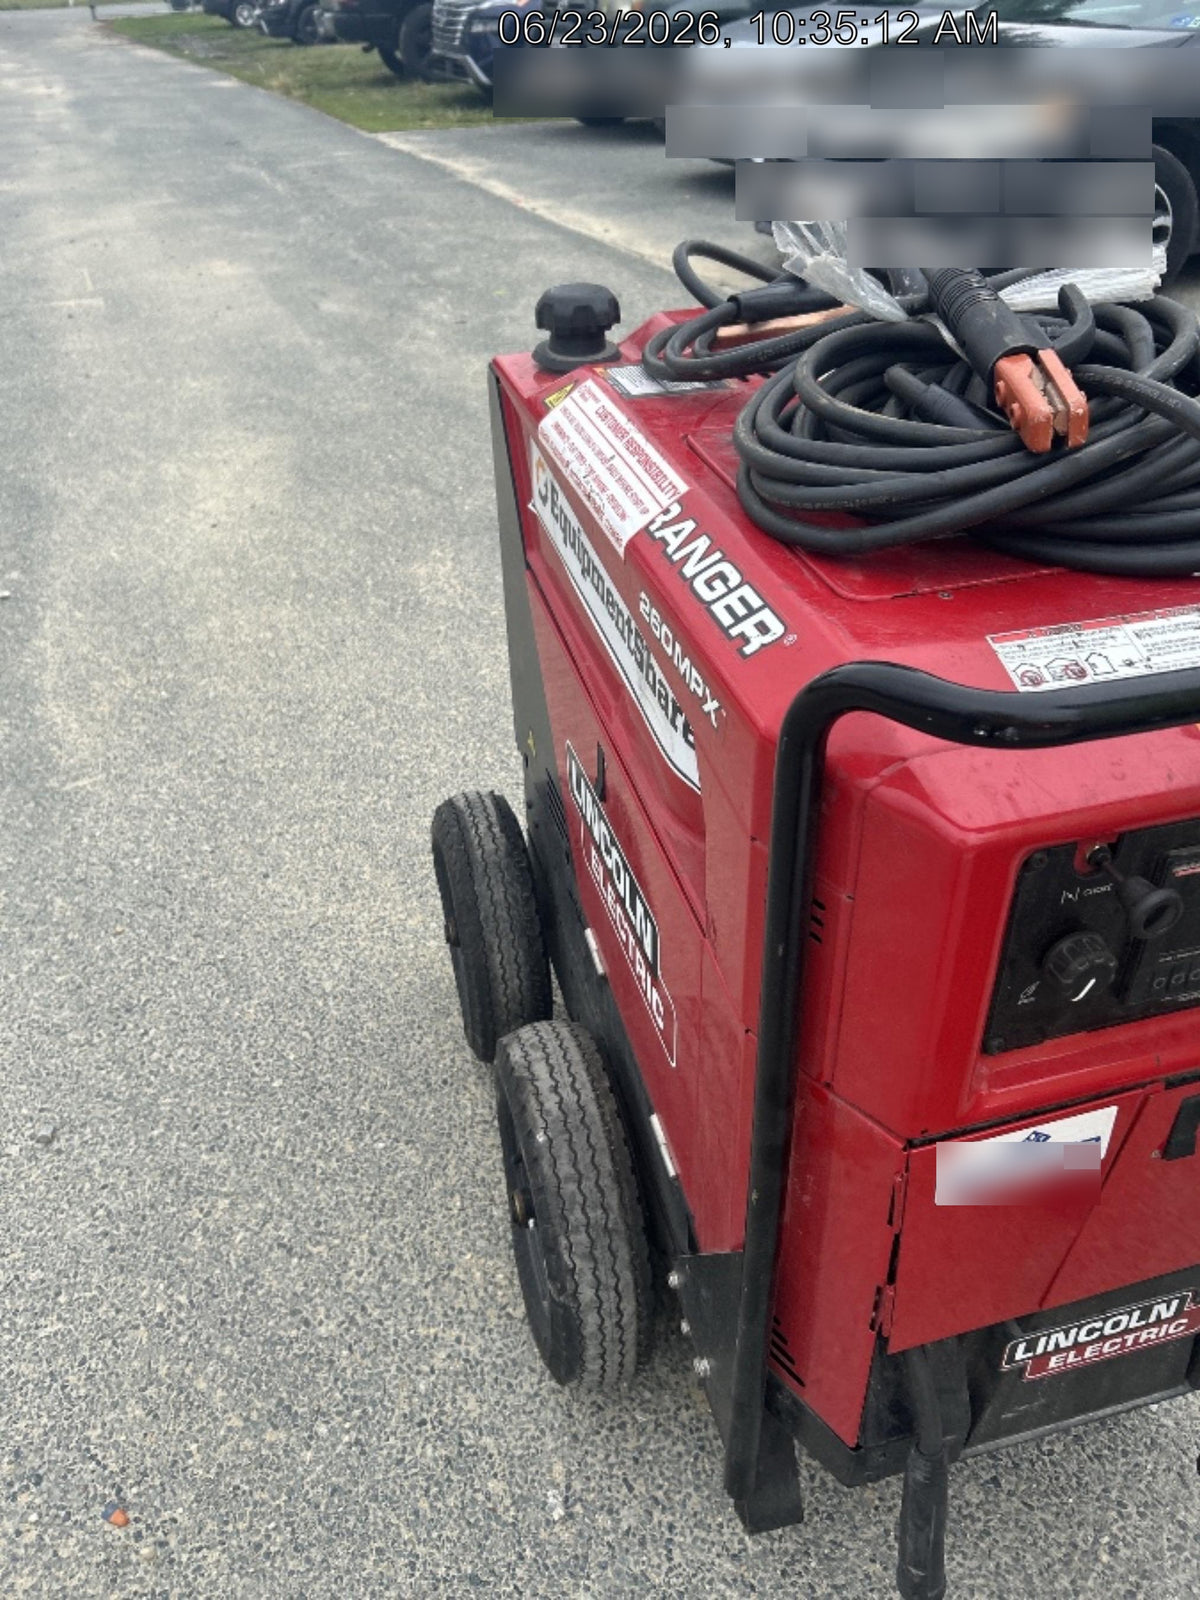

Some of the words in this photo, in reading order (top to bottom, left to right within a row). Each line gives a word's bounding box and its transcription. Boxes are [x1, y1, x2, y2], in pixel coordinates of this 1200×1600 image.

[595, 405, 630, 442] CUSTOMER
[626, 435, 681, 500] RESPONSIBILITY
[549, 487, 696, 751] EquipmentShare
[648, 501, 785, 656] RANGER
[571, 759, 654, 964] LINCOLN
[590, 845, 664, 1030] ELECTRIC
[1014, 1299, 1180, 1361] LINCOLN
[1048, 1318, 1189, 1370] ELECTRIC
